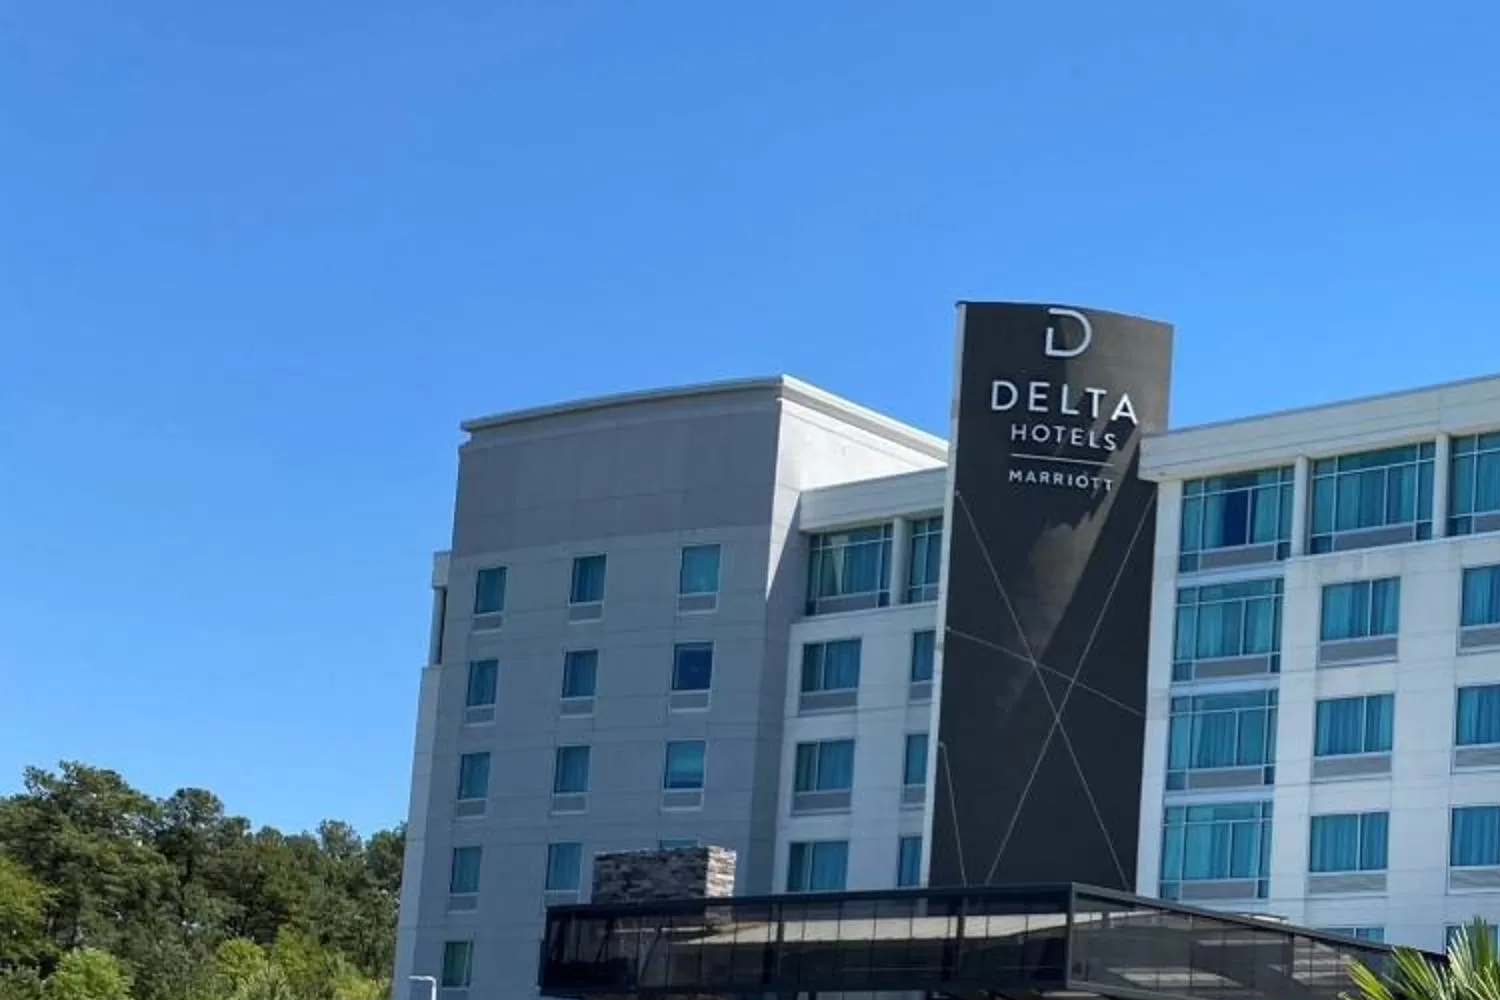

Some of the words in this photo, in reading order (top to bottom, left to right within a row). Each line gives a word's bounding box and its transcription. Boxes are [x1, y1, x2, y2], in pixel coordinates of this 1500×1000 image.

[991, 380, 1139, 425] DELTA
[1011, 424, 1117, 451] HOTELS
[1008, 469, 1113, 492] MARRIOTT
